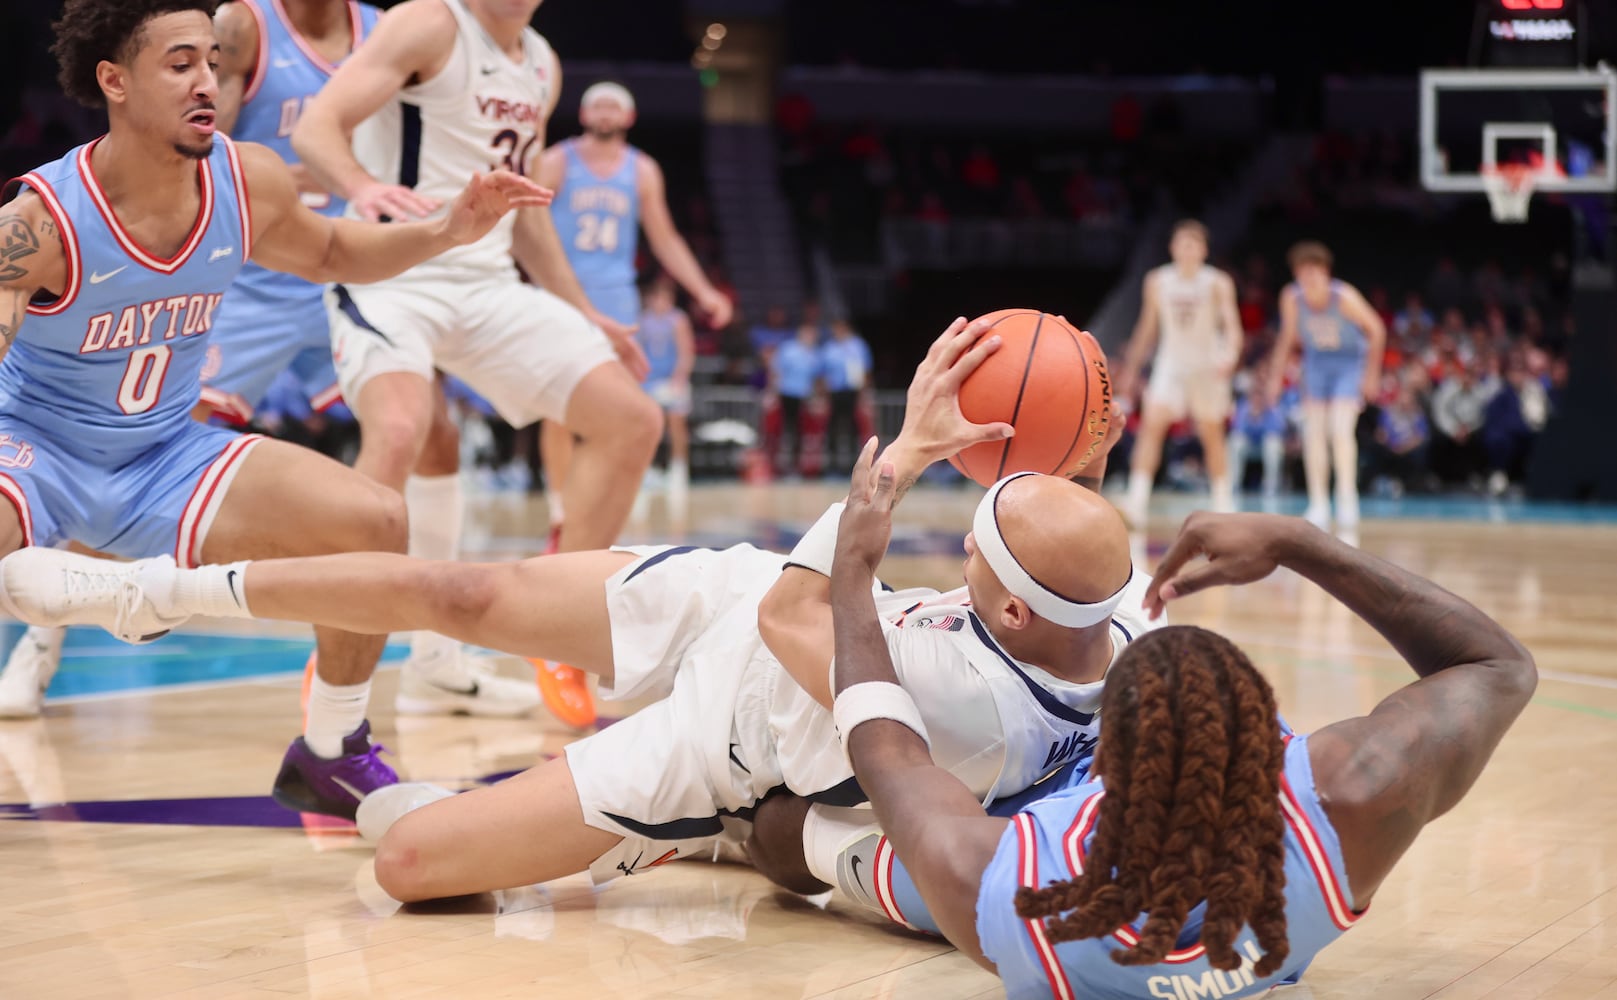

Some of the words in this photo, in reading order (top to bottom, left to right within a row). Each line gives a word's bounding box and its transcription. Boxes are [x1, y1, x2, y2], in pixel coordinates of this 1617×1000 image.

[575, 213, 618, 253] 24
[79, 292, 224, 354] DAYTON
[116, 344, 173, 416] 0
